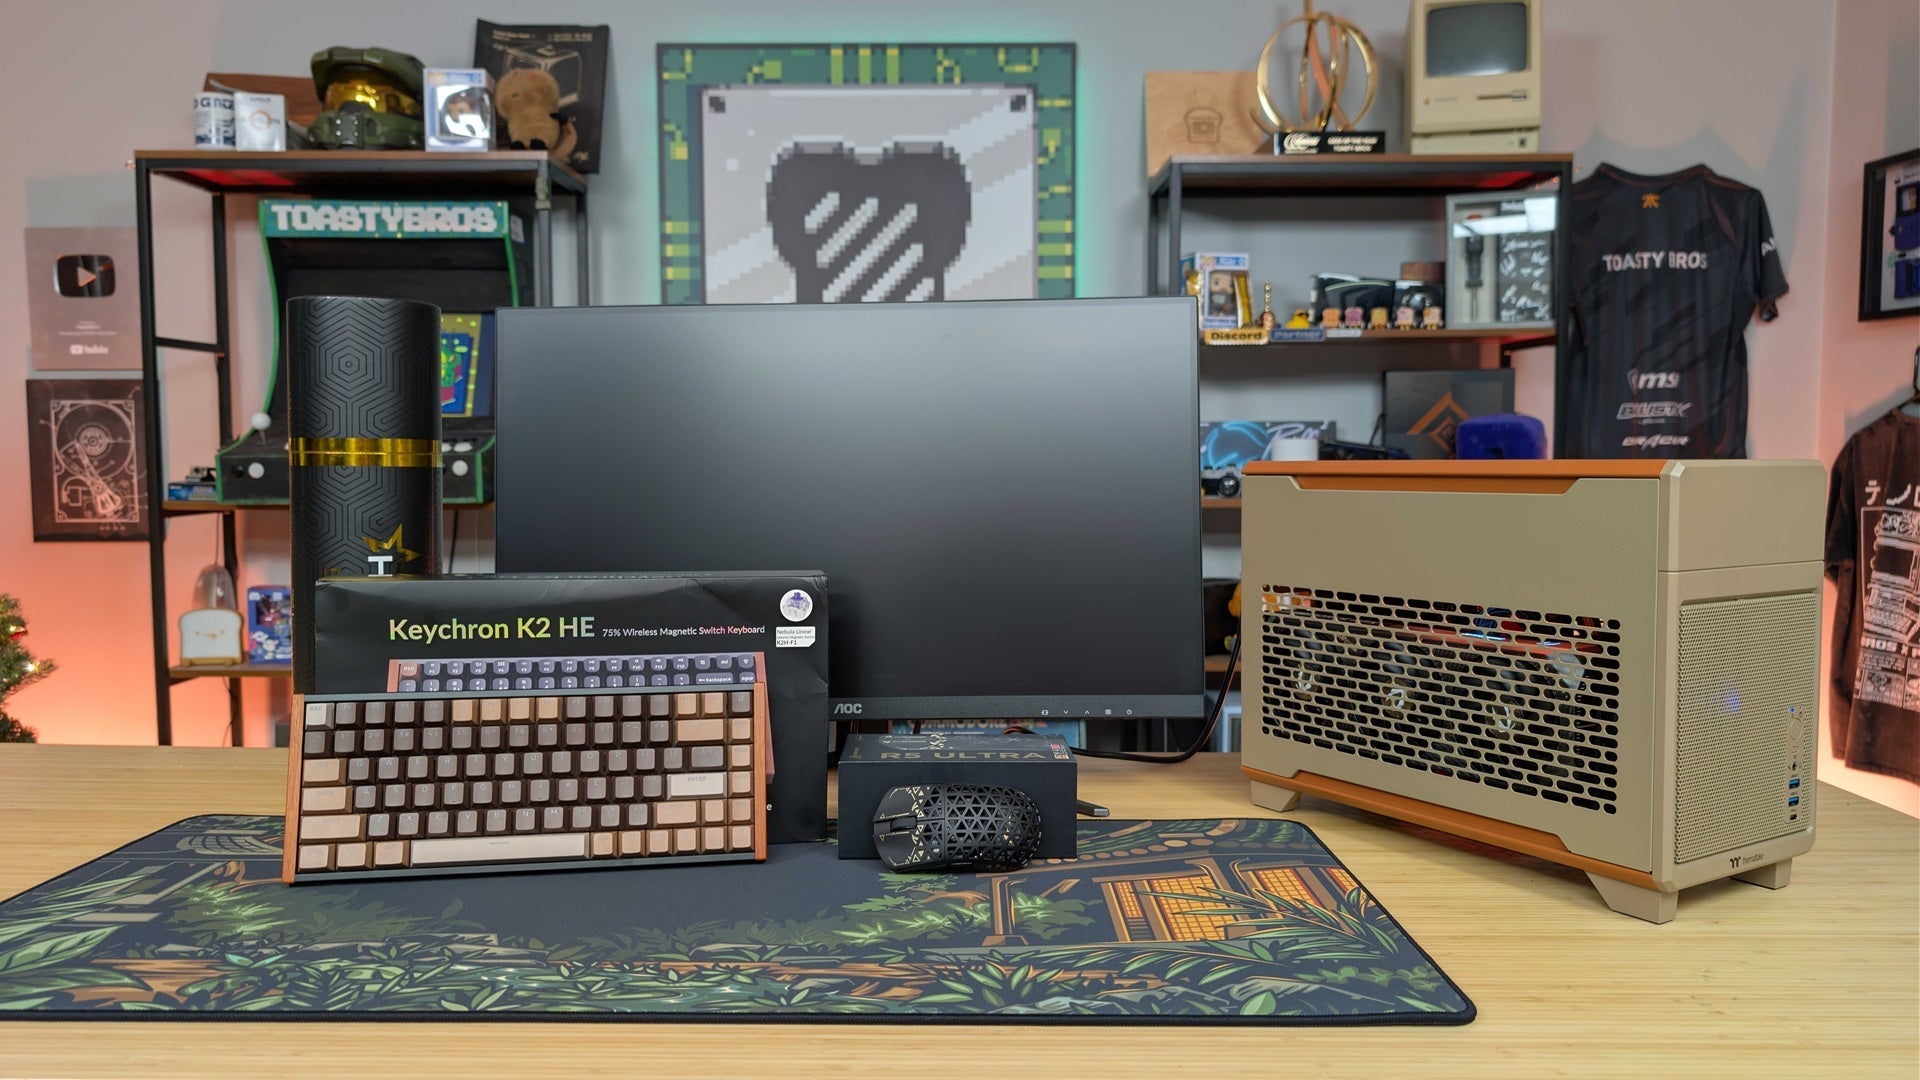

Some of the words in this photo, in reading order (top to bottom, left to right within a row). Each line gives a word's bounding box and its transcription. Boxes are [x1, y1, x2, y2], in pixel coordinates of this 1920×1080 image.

[271, 204, 497, 232] TOASTYBROS
[1602, 251, 1665, 271] TOASTY
[1668, 251, 1708, 269] BROS
[1210, 331, 1262, 341] Discord
[1274, 330, 1322, 340] Partner
[389, 618, 509, 644] Keychron
[517, 617, 551, 639] K2
[559, 616, 595, 638] HE
[602, 628, 621, 637] 75%
[623, 628, 658, 637] Wireless
[660, 627, 698, 637] Magnetic
[699, 625, 726, 635] Switch
[727, 625, 766, 635] Keyboard
[834, 703, 862, 714] AOC
